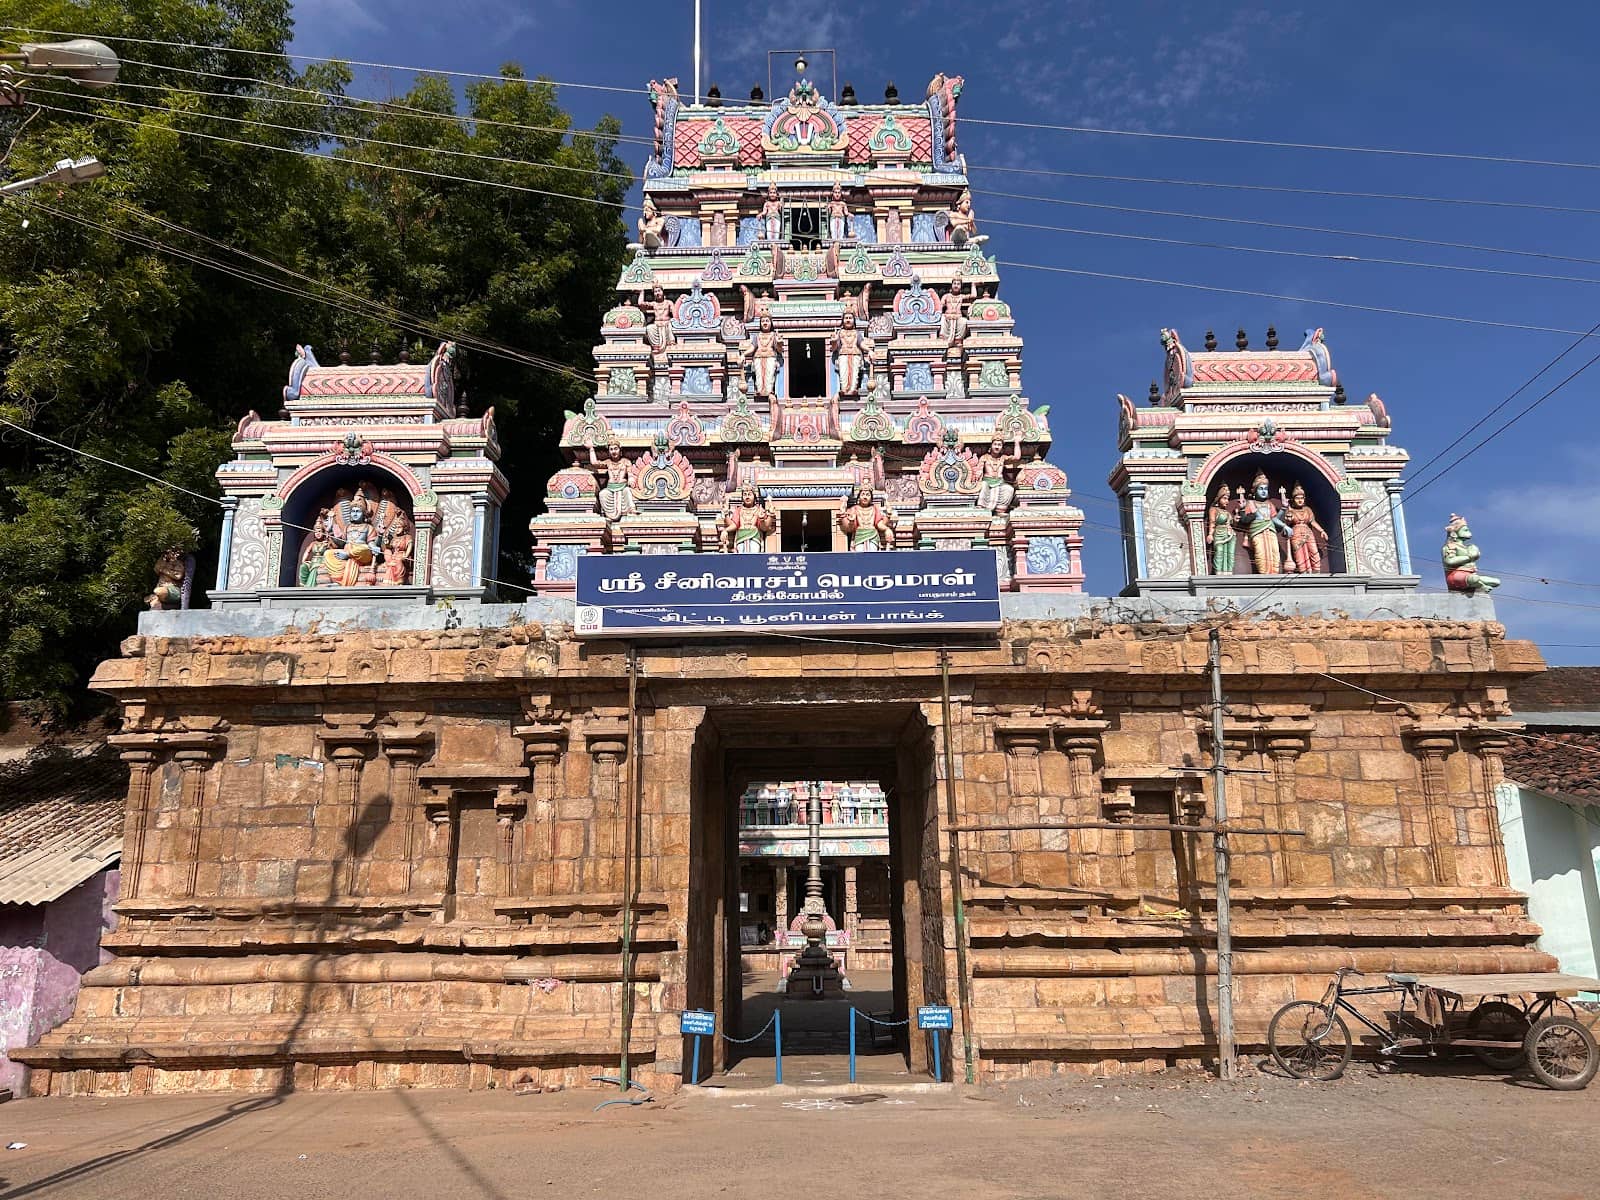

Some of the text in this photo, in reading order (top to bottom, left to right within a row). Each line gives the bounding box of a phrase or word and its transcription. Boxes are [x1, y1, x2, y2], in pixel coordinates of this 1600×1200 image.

[655, 571, 808, 590] சீனிவாசப்
[817, 568, 977, 590] பெருமாள்
[730, 589, 844, 602] திருக்கோயில்
[739, 611, 856, 625] யூனியன்
[866, 609, 945, 620] பாங்க்
